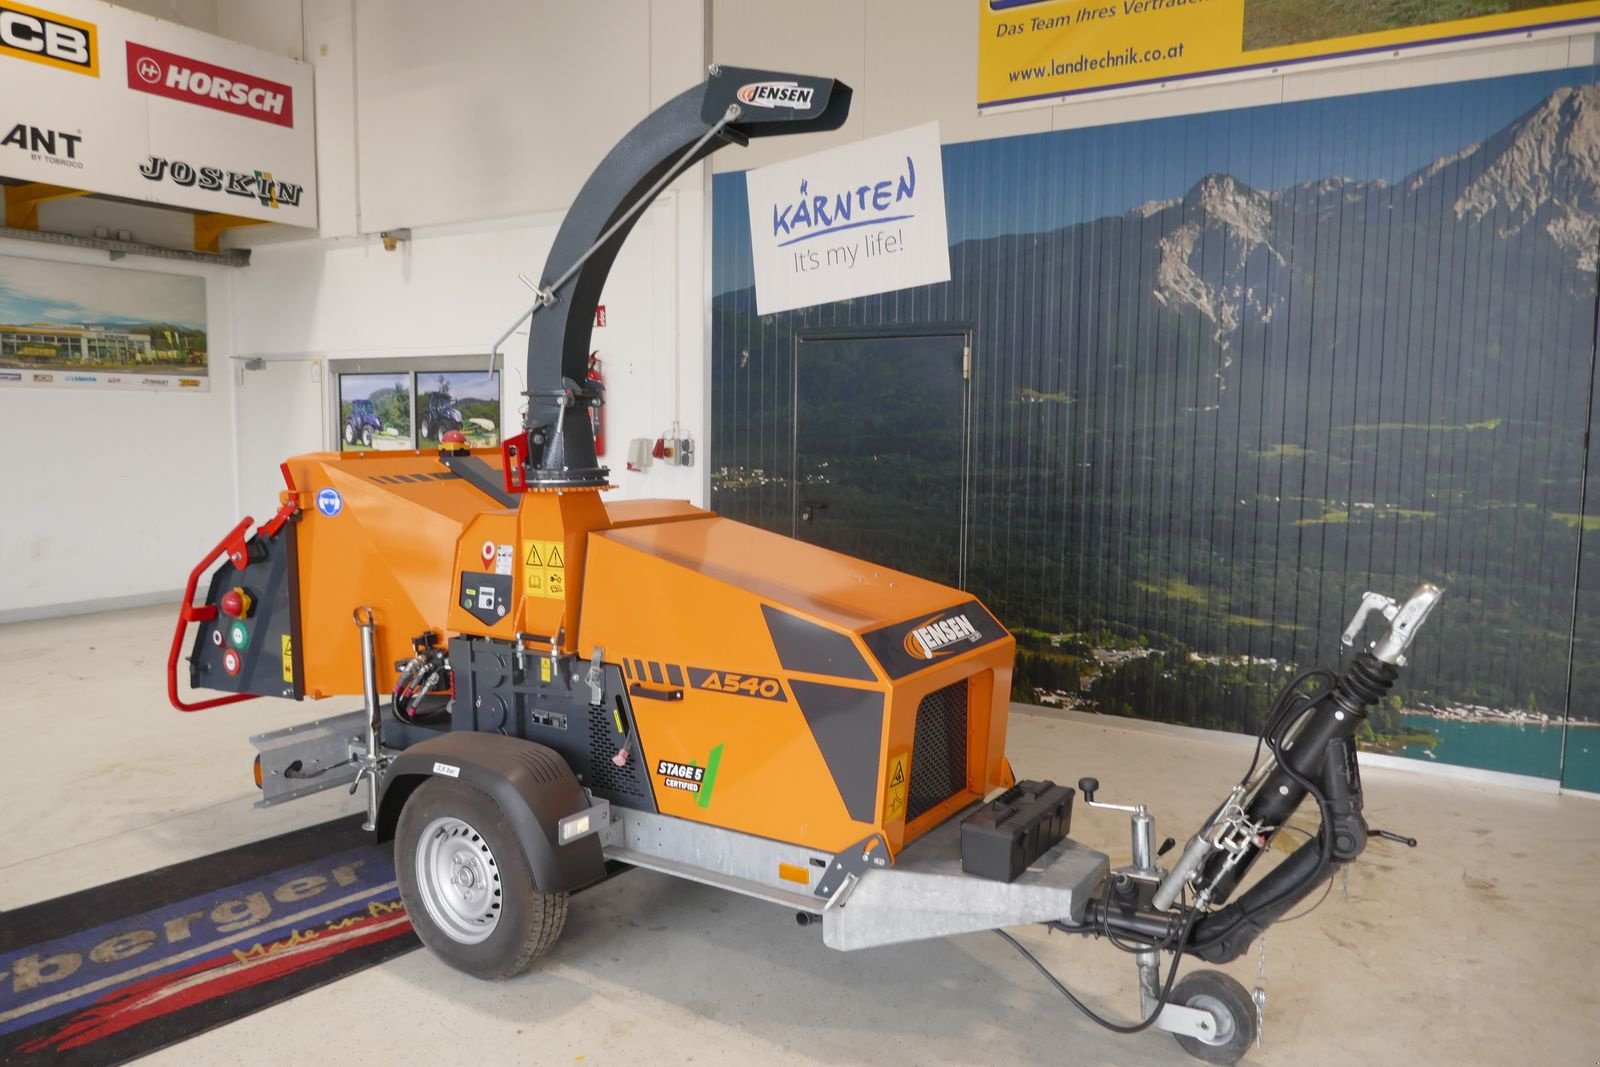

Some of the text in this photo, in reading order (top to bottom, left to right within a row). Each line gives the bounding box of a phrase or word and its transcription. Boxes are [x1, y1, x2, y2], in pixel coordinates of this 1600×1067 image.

[996, 23, 1024, 38] Das
[1030, 15, 1070, 32] Team
[1076, 4, 1116, 24] Ihres
[1008, 43, 1185, 83] www.landtechnik.co.at
[165, 64, 284, 115] HORSCH
[750, 86, 812, 103] JENSEN
[1, 123, 82, 159] ANT
[31, 153, 84, 169] BY TOBROCO
[139, 155, 303, 207] JOSKIN
[773, 156, 916, 237] KÄRNTEN
[794, 229, 904, 273] It's my life!
[912, 614, 977, 659] JENSEN
[701, 672, 779, 697] A540
[659, 762, 703, 781] STAGE 5
[665, 778, 699, 792] CERTIFIED
[0, 859, 365, 993] berger
[232, 928, 320, 964] Made
[328, 912, 365, 930] in
